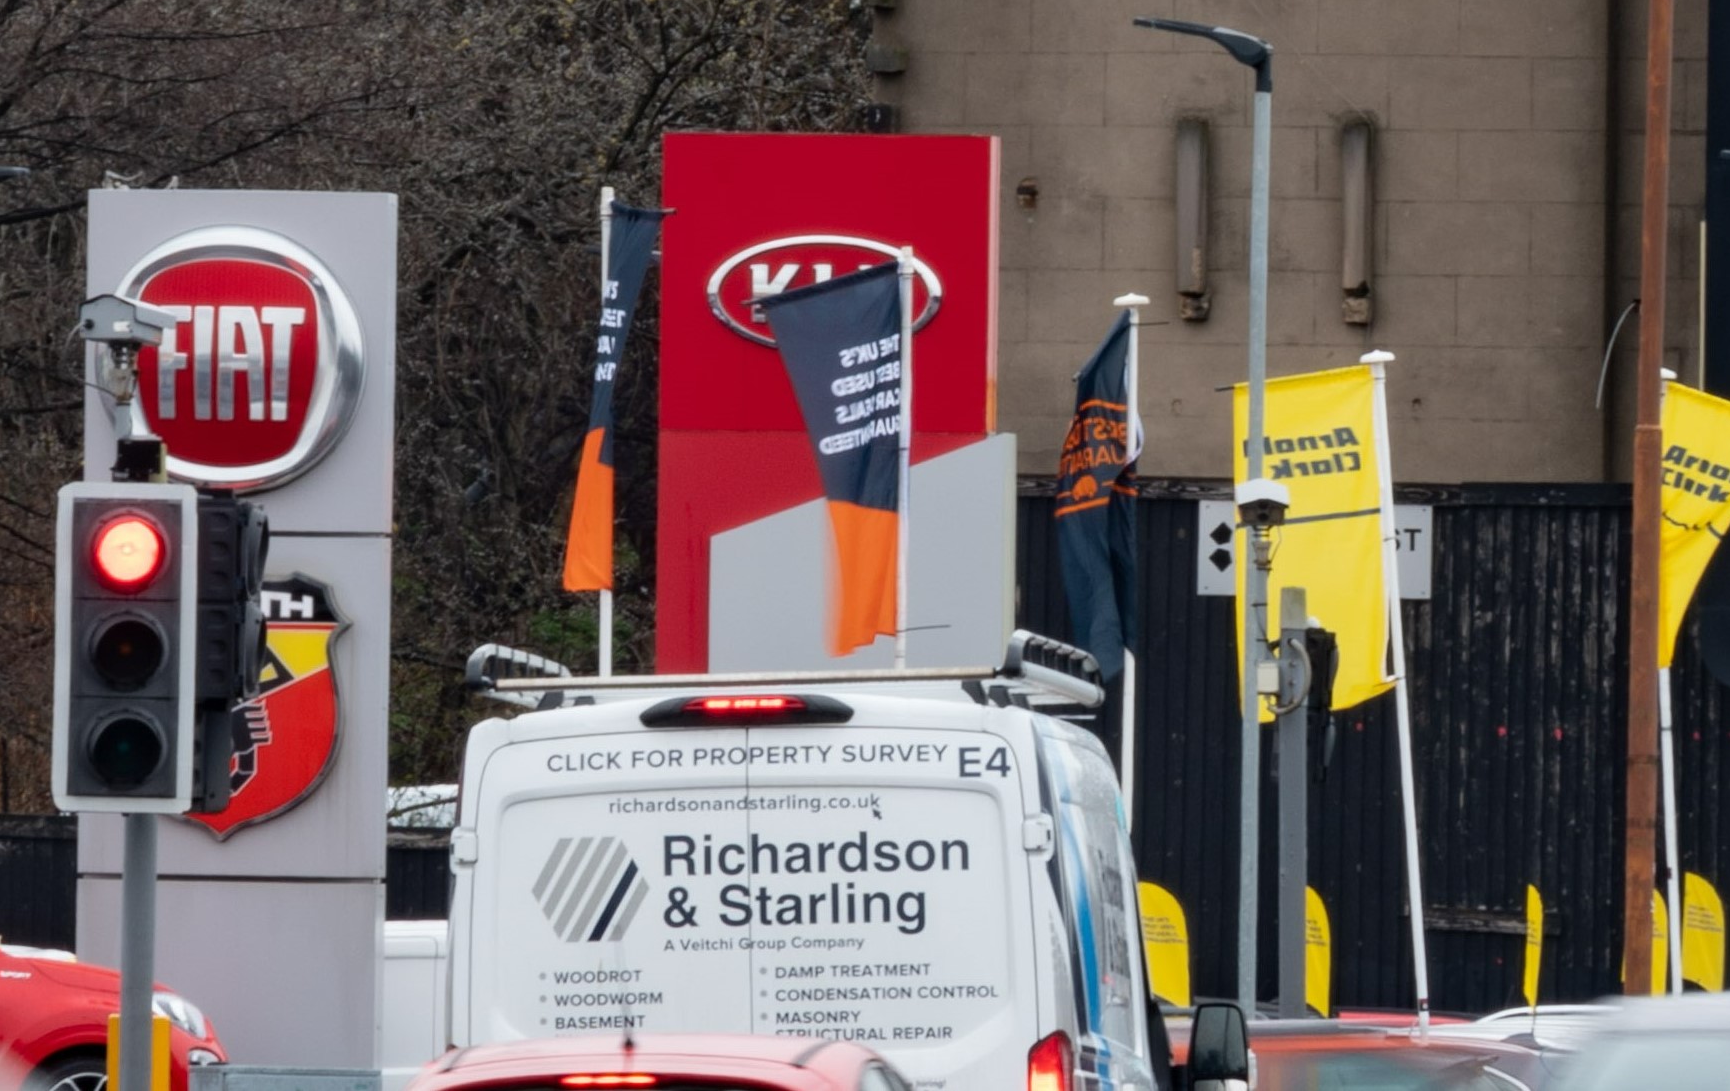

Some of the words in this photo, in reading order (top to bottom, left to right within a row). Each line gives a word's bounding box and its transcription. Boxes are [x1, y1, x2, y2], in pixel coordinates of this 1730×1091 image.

[157, 305, 306, 421] FIAT
[547, 751, 622, 772] CLICK
[631, 748, 683, 769] FOR
[693, 745, 832, 766] PROPERTY
[842, 744, 948, 763] SURVEY
[958, 746, 1011, 778] E4
[609, 793, 881, 814] richardsonandstarling.co.uk
[663, 831, 971, 876] Richardson
[663, 886, 698, 928] &
[719, 882, 926, 935] Starling
[663, 939, 676, 952] A
[680, 937, 734, 952] Veitchi
[738, 936, 787, 953] Group
[791, 935, 866, 952] Company
[554, 969, 642, 984] WOODROT
[775, 965, 825, 978] DAMP
[830, 963, 932, 977] TREATMENT
[554, 991, 663, 1007] WOODWORM
[775, 986, 912, 1001] CONDENSATION
[917, 985, 999, 999] CONTROL
[554, 1015, 645, 1029] BASEMENT
[775, 1011, 861, 1024] MASONRY
[893, 1026, 953, 1040] REPAIR
